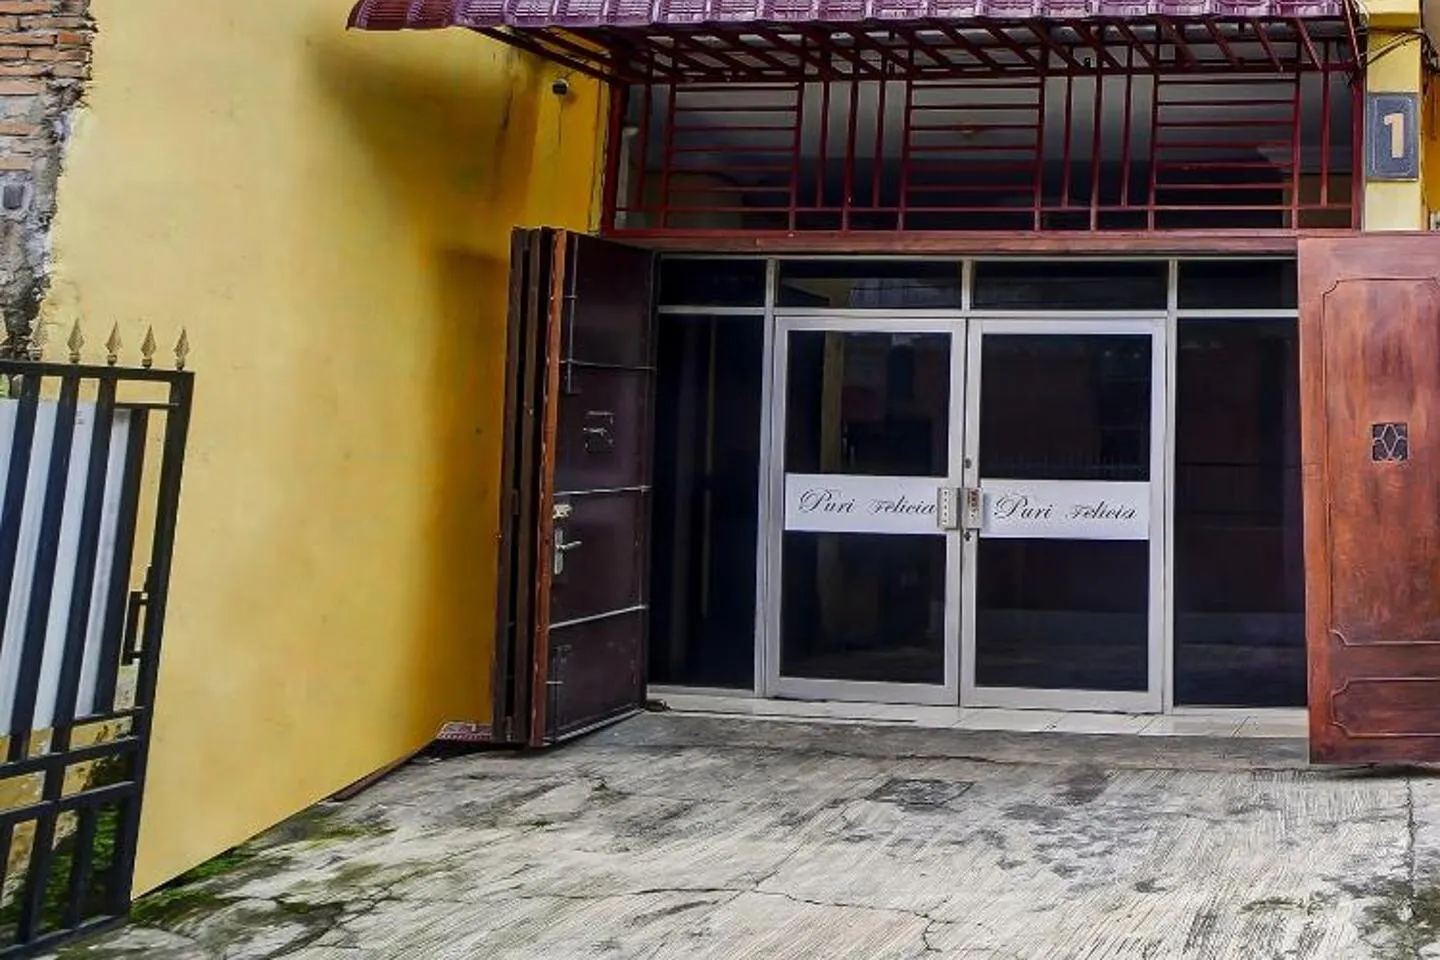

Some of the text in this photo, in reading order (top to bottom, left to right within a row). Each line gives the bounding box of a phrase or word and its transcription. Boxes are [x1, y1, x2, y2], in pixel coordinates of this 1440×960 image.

[1383, 113, 1404, 158] 1
[798, 487, 937, 515] Puri Felicia
[994, 493, 1136, 520] Puri Felicia
